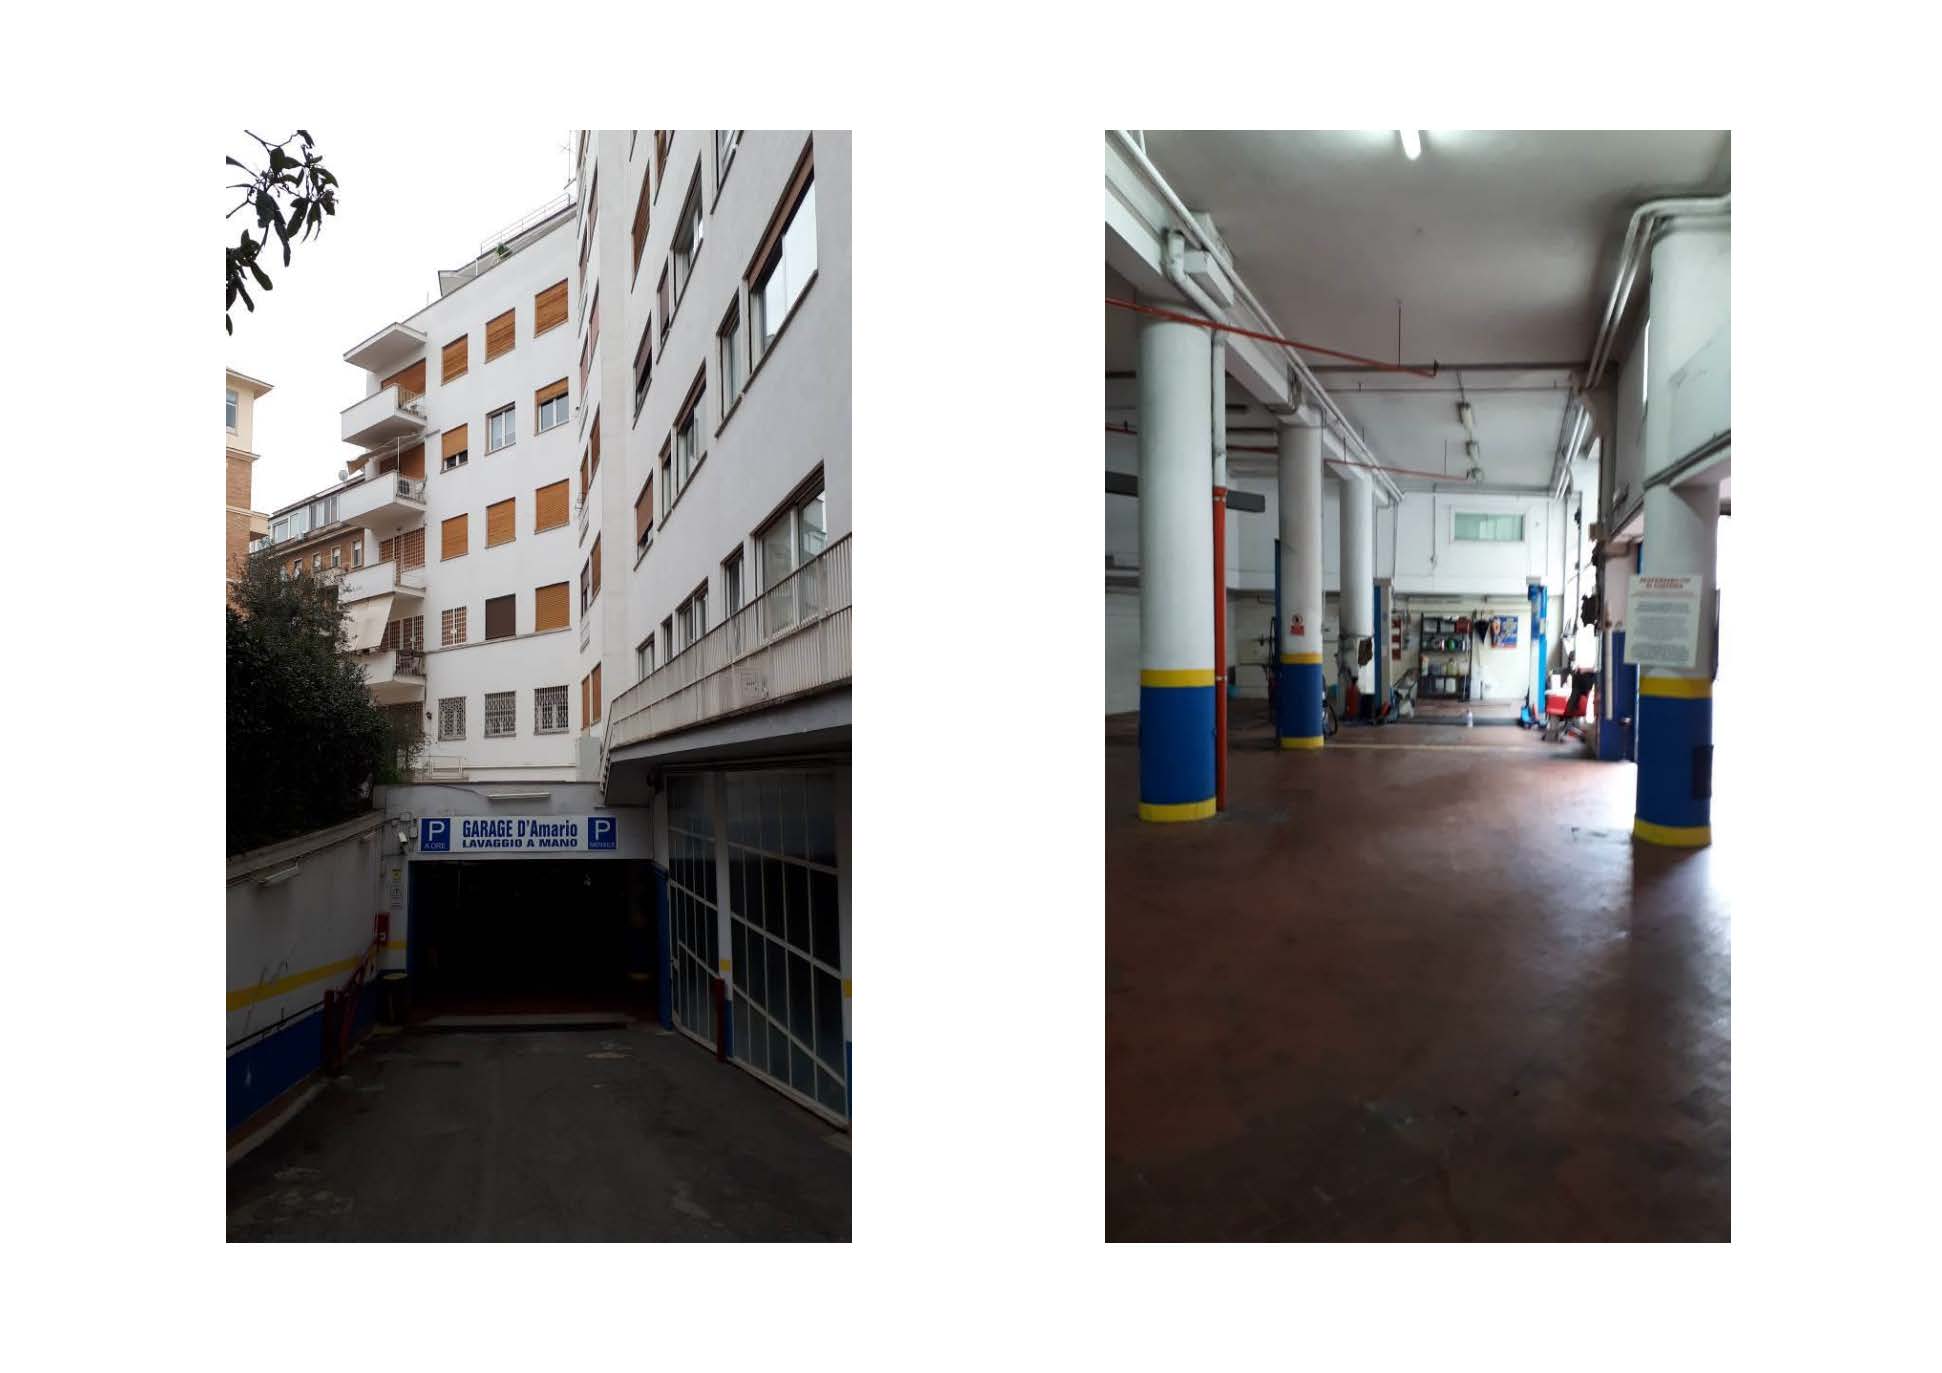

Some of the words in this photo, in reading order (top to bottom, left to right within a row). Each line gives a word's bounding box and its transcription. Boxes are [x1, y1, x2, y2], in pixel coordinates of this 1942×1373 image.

[428, 821, 446, 842] P
[462, 820, 513, 838] GARAGE
[517, 820, 578, 838] D'Amario
[595, 820, 611, 841] P
[462, 839, 523, 849] LAVAGGIO
[526, 839, 535, 848] A
[538, 839, 578, 848] MANO
